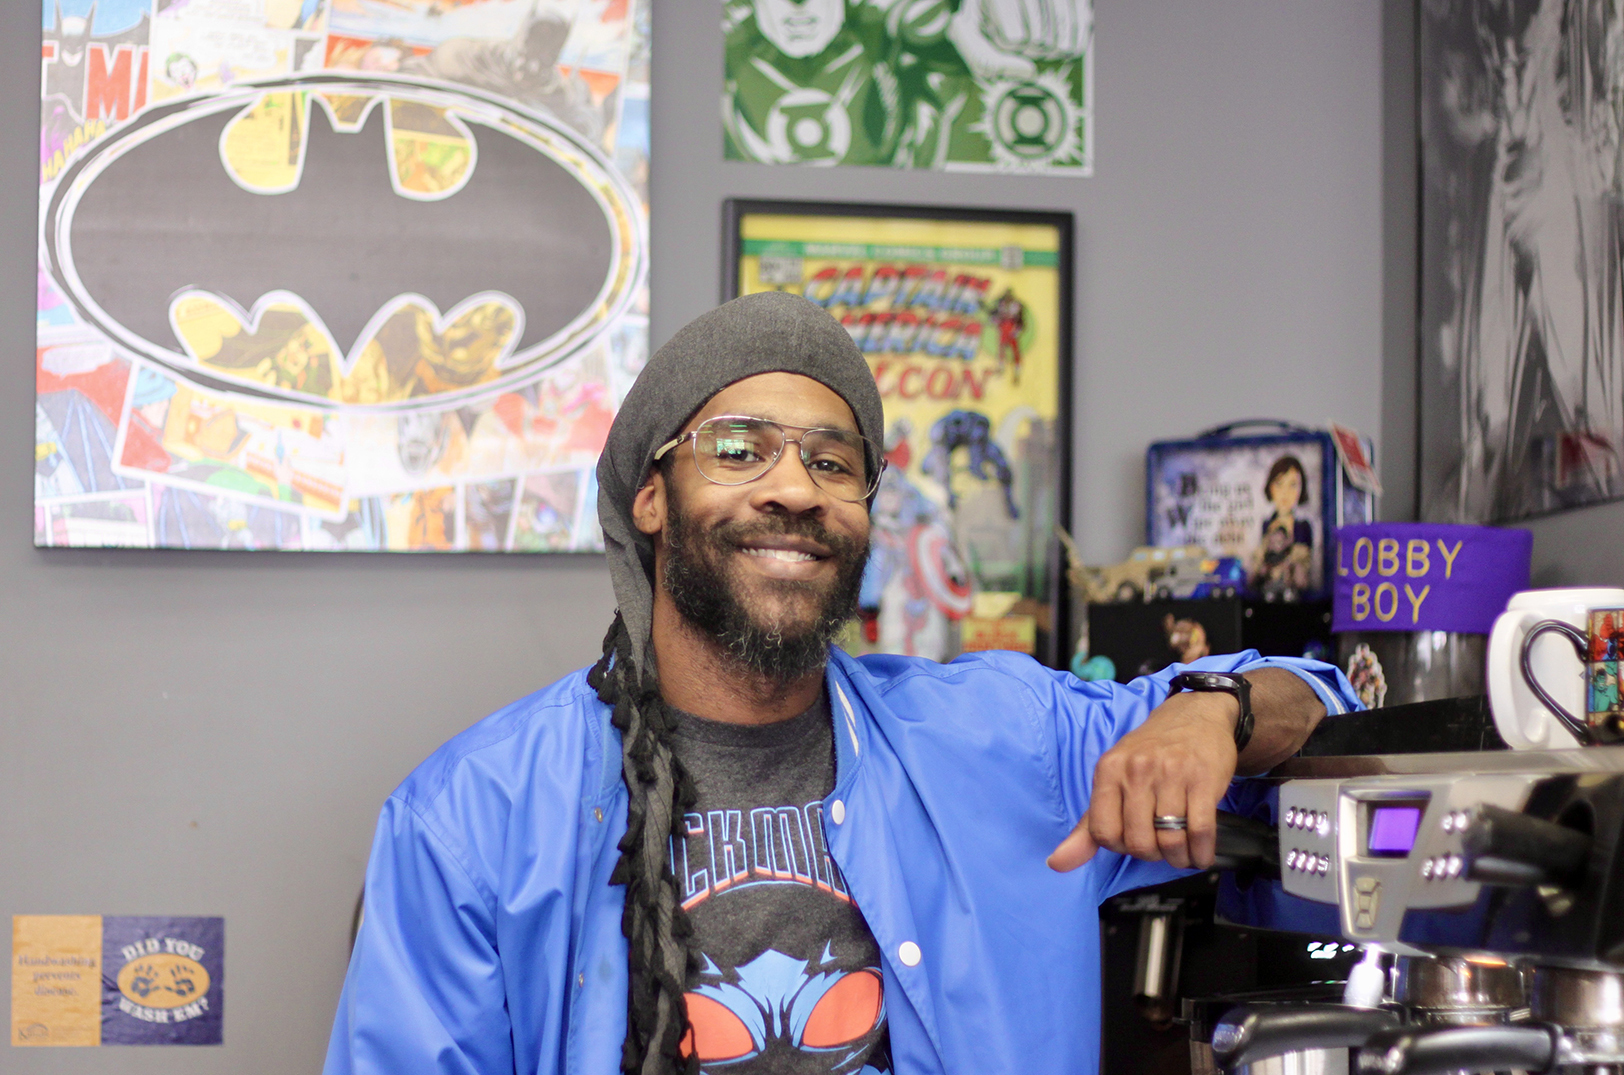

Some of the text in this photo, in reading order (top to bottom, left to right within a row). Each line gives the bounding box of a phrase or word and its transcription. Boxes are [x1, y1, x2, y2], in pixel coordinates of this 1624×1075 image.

[841, 311, 982, 360] MERICA
[872, 361, 999, 400] LCON
[1337, 537, 1463, 580] LOBBY
[1352, 582, 1430, 624] BOY
[122, 936, 205, 961] DID YOU
[119, 996, 169, 1024] WASH
